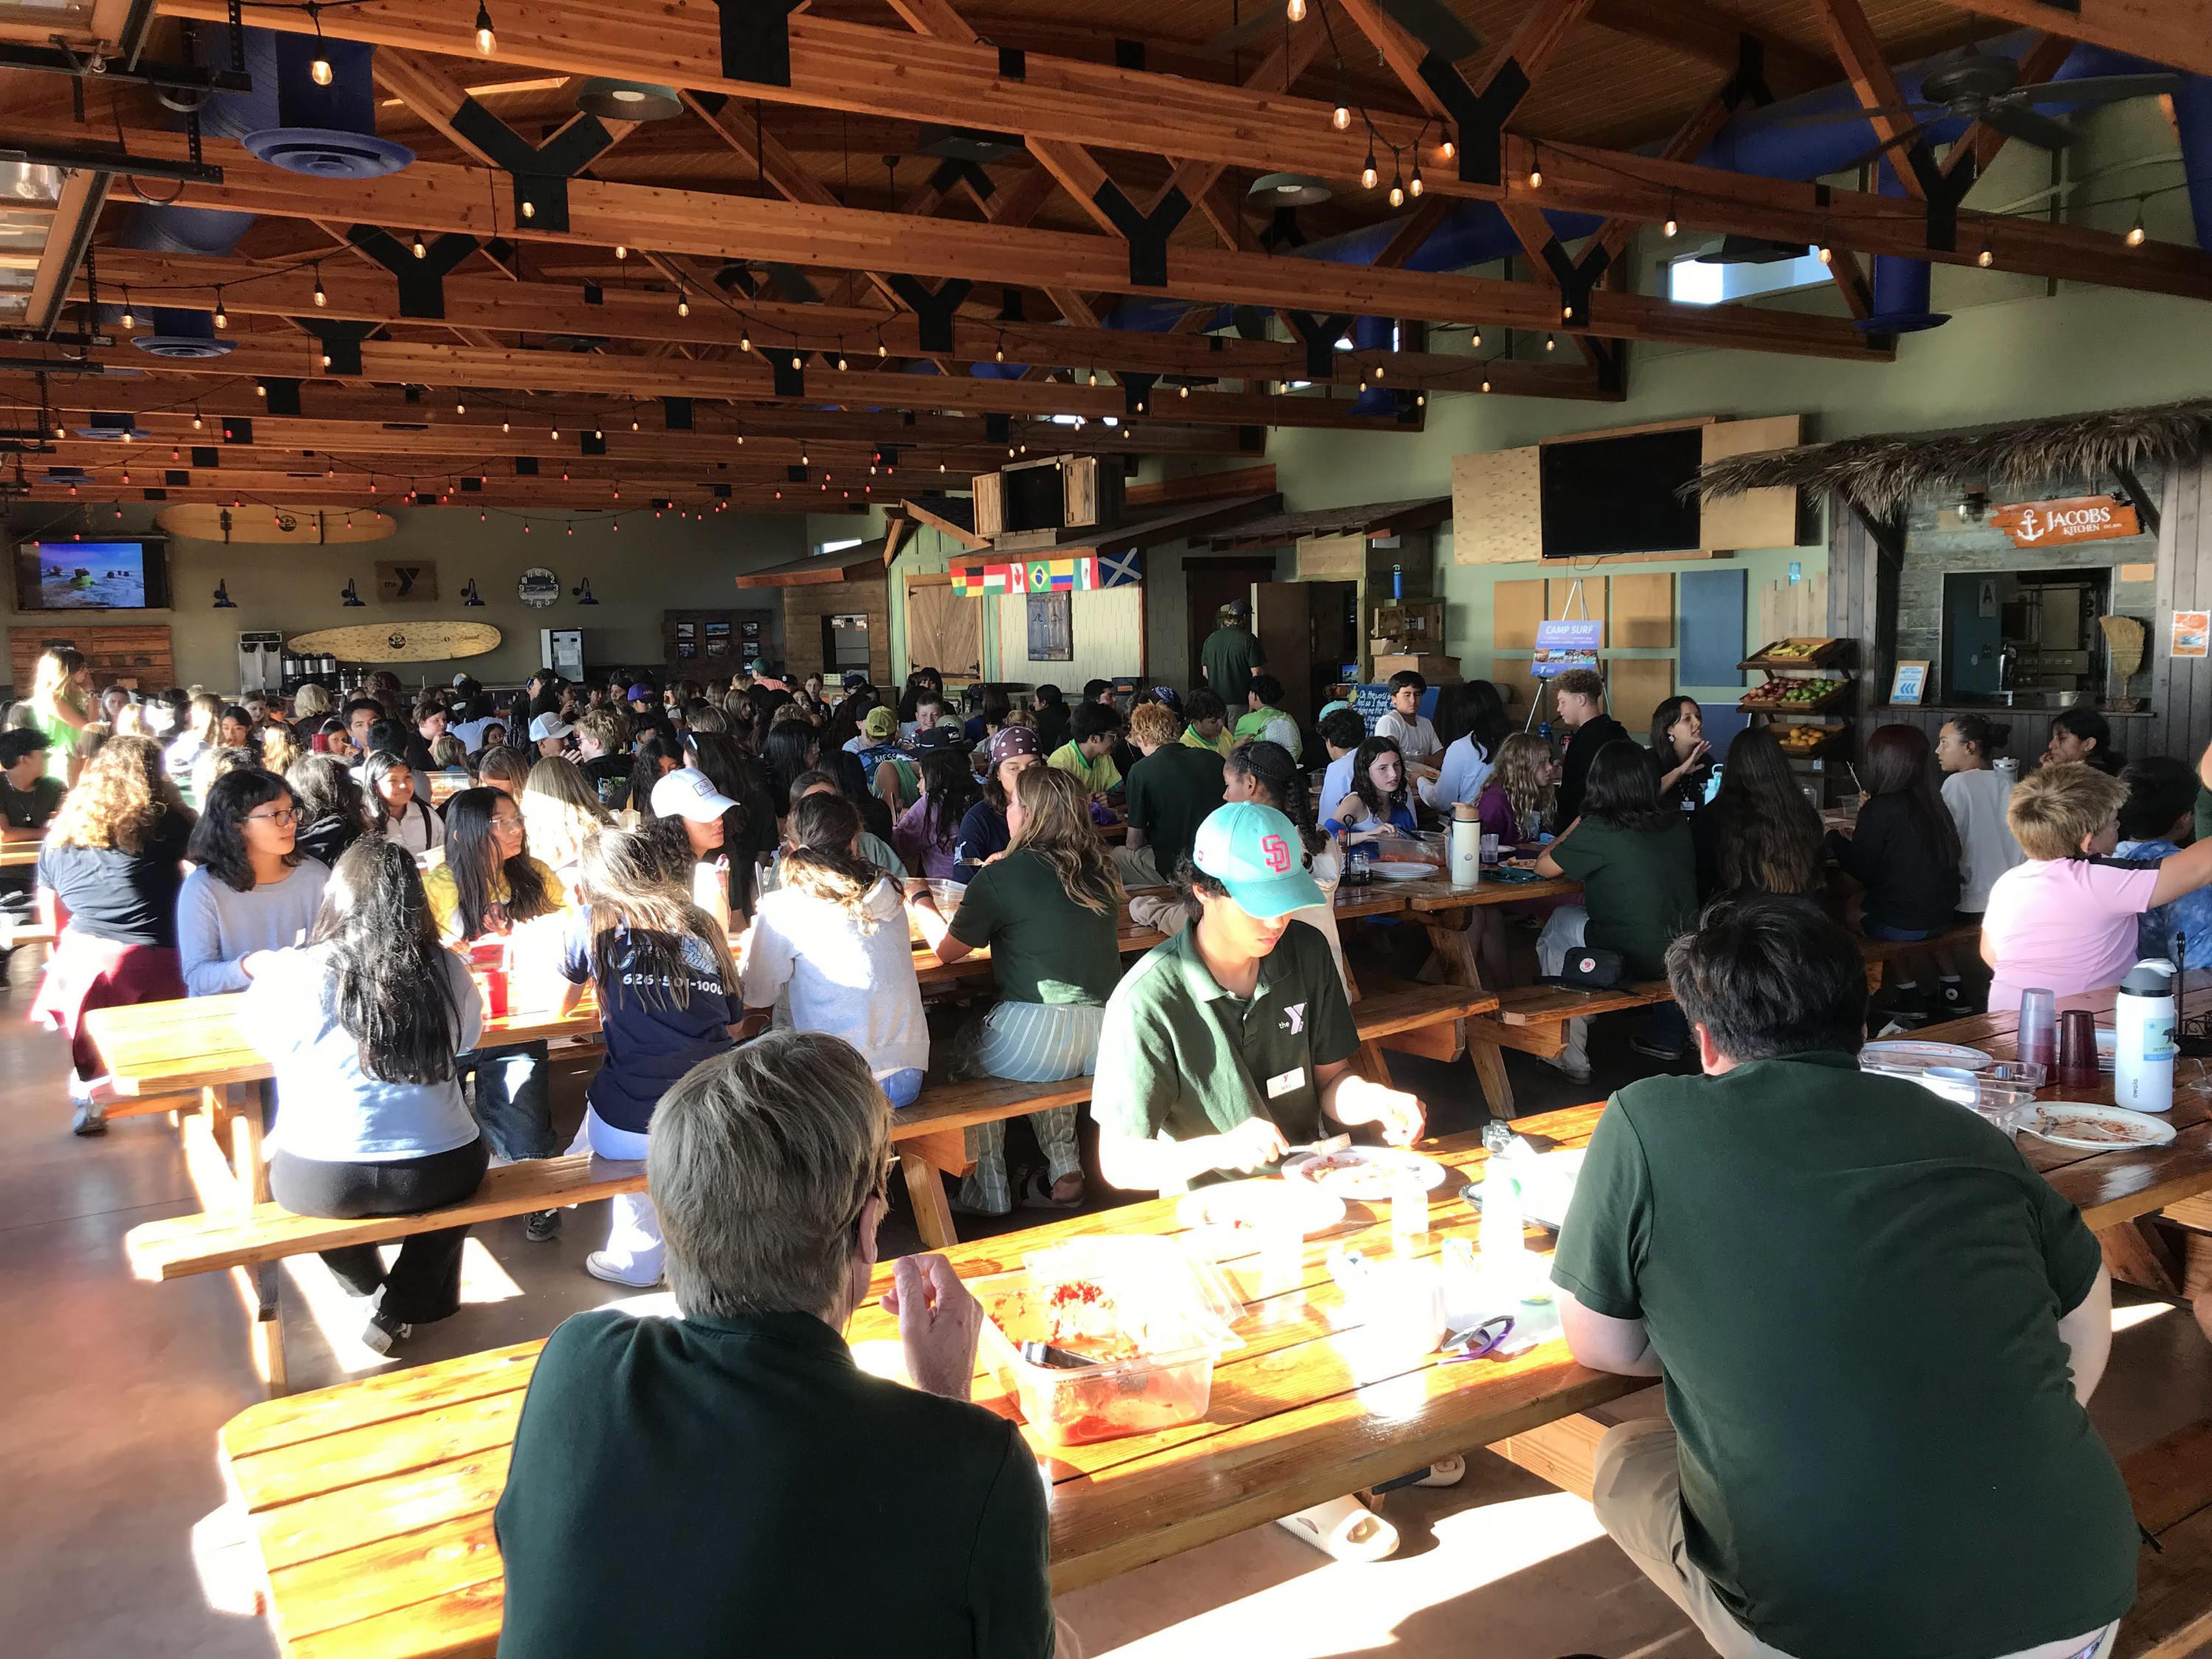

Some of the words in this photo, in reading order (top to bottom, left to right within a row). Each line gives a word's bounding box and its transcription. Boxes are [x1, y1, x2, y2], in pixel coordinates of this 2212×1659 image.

[2047, 507, 2111, 532] JACOBS
[2064, 524, 2100, 536] KITCHEN
[518, 584, 524, 592] 9
[553, 583, 559, 591] 3
[1545, 625, 1569, 634] CAMP
[1571, 625, 1593, 634] SURF
[1262, 834, 1291, 874] SD
[1279, 1021, 1290, 1029] the
